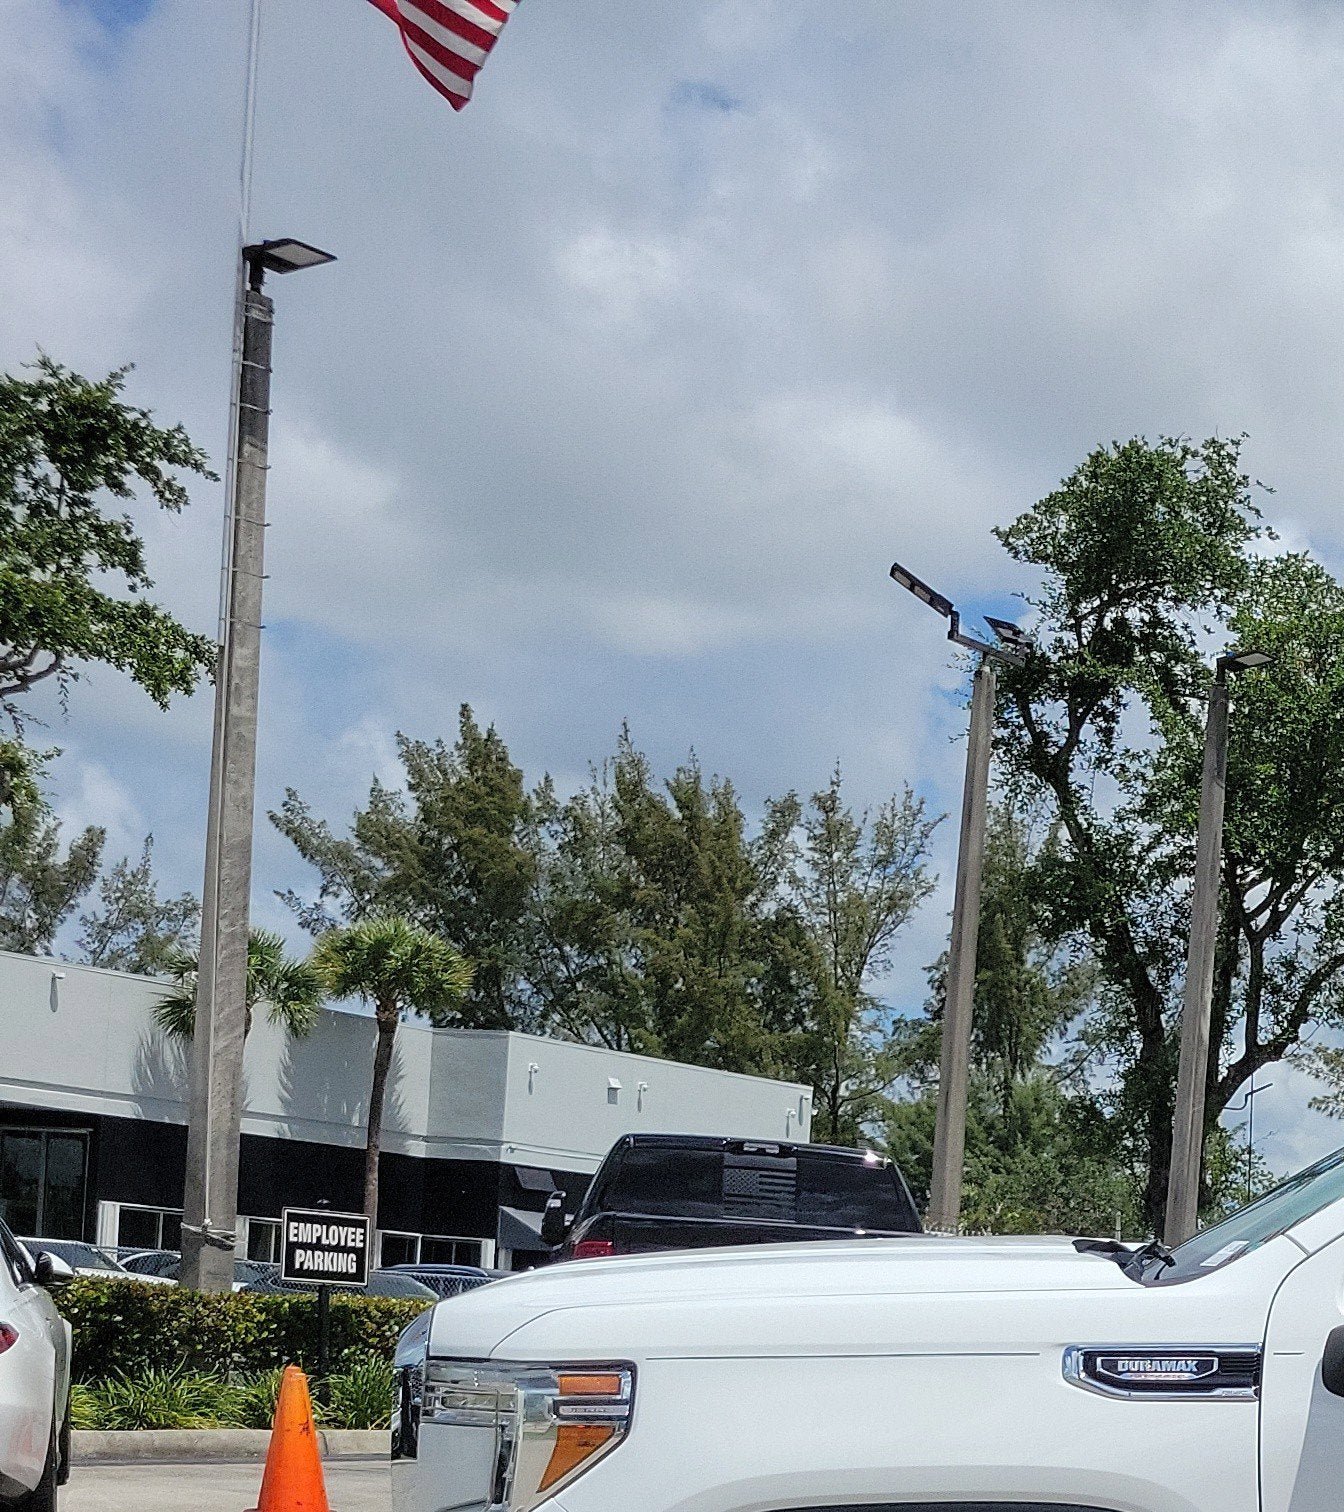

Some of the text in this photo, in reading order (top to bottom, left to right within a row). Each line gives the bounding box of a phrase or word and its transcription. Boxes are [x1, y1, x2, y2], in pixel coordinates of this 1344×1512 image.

[289, 1221, 365, 1248] EMPLOYEE
[294, 1248, 357, 1274] PARKING
[1117, 1360, 1198, 1372] DURAMAX
